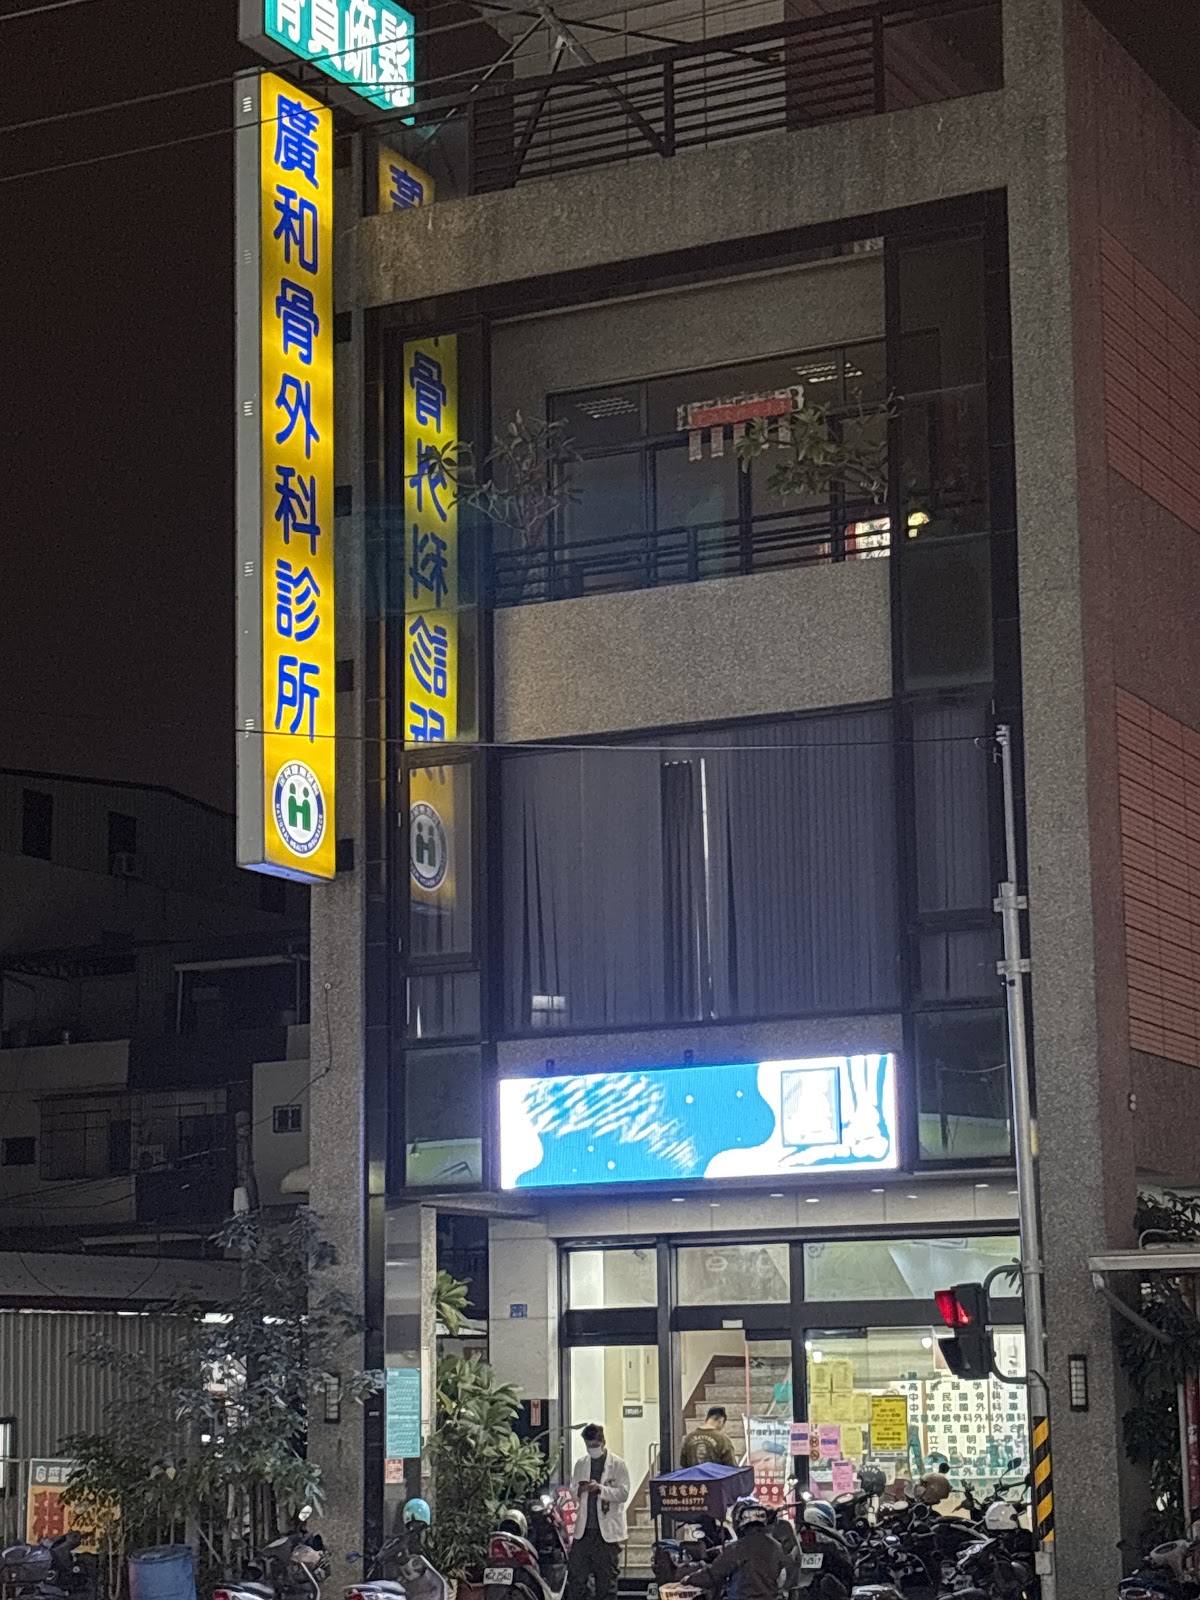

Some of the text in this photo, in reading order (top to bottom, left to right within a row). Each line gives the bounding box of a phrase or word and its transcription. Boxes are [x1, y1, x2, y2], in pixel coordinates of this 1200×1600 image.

[274, 94, 321, 743] 廣和骨外科診所
